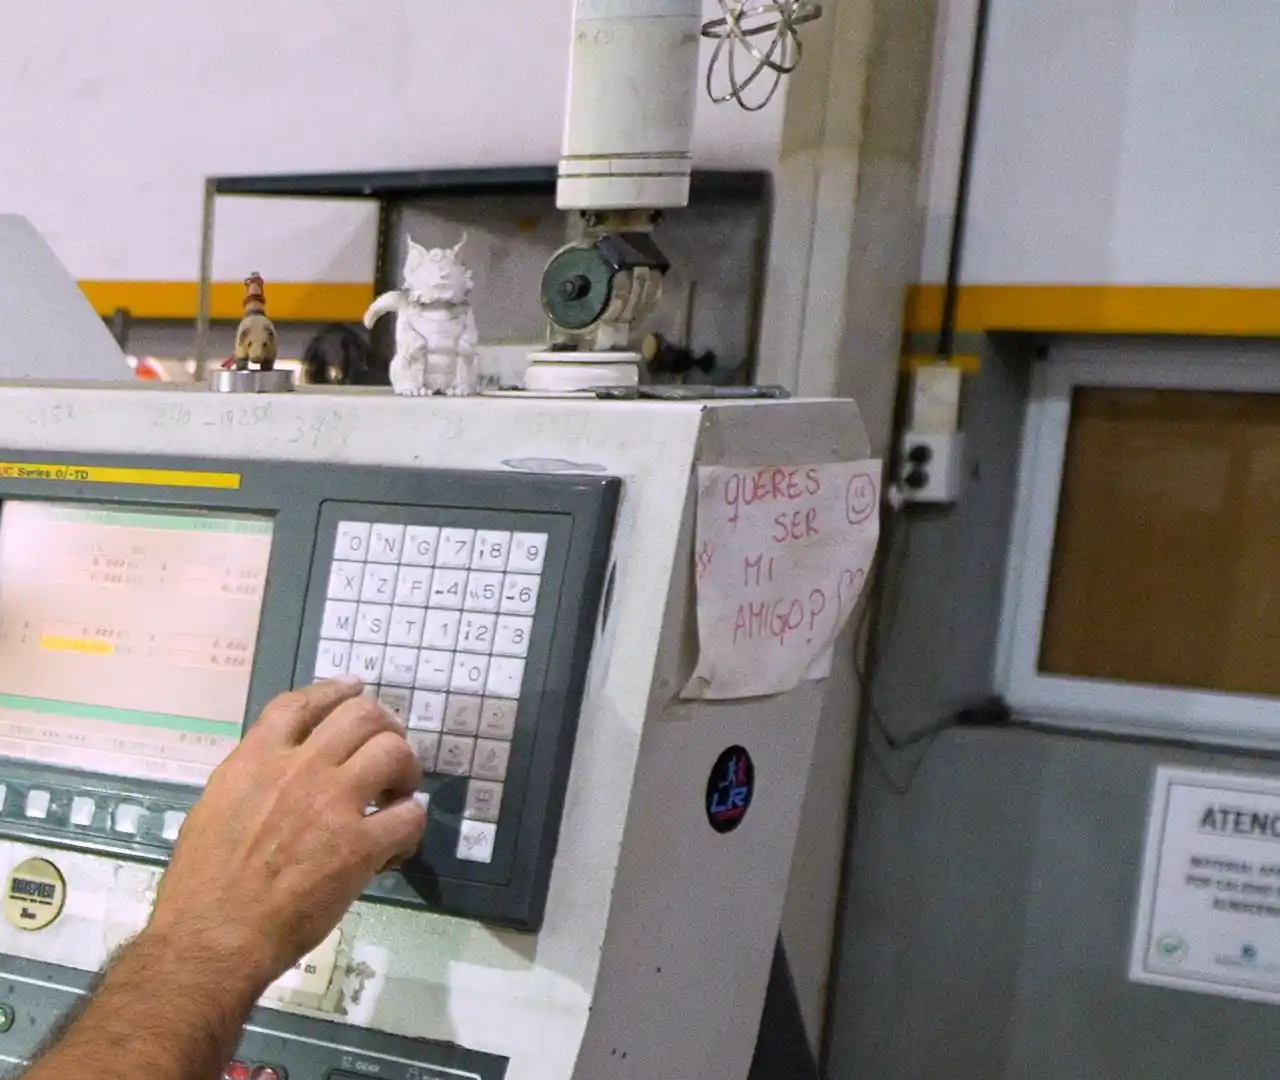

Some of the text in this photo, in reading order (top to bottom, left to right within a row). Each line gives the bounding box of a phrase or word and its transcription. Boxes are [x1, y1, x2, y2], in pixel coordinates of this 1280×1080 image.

[17, 466, 51, 479] Series
[772, 507, 820, 543] SER
[384, 537, 396, 553] N
[417, 540, 431, 555] G
[454, 540, 467, 555] 7
[490, 543, 502, 559] 8
[527, 545, 539, 561] 9
[743, 555, 775, 587] MI
[344, 575, 354, 592] X
[377, 578, 389, 593] Z
[412, 580, 423, 595] F
[446, 581, 459, 597] 4
[483, 584, 495, 599] 5
[519, 586, 532, 602] 6
[336, 615, 349, 629] M
[733, 588, 827, 645] AMIGO?
[370, 618, 382, 634] S
[405, 620, 417, 636] T
[441, 622, 448, 637] 1
[476, 625, 489, 641] 2
[512, 628, 524, 644] 3
[332, 653, 344, 668] U
[363, 656, 378, 671] W
